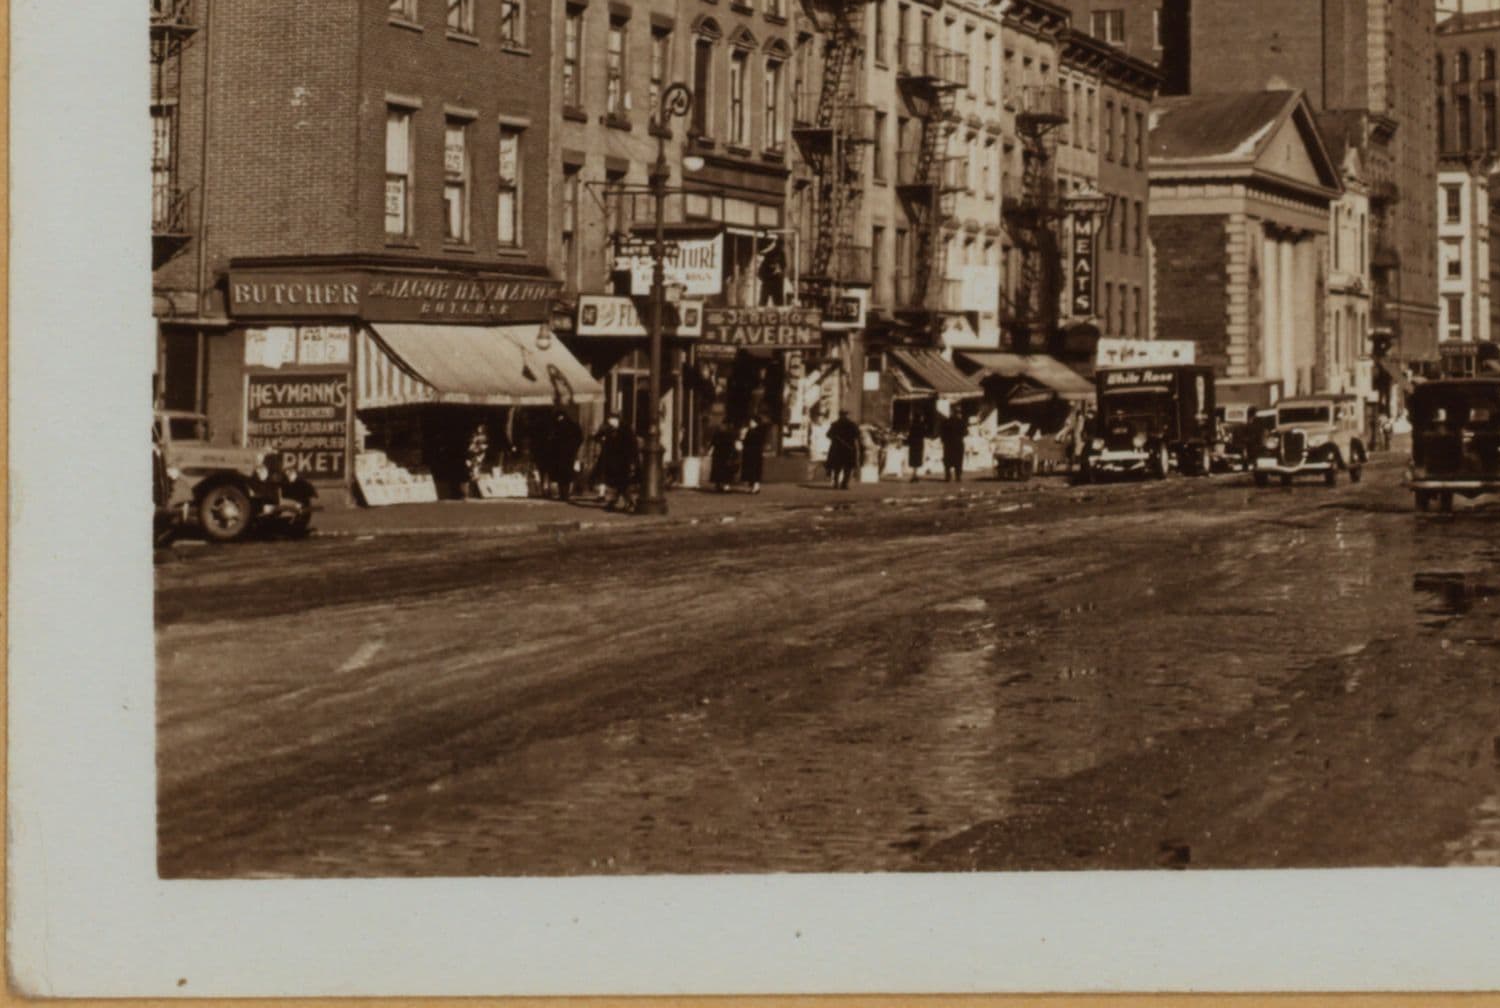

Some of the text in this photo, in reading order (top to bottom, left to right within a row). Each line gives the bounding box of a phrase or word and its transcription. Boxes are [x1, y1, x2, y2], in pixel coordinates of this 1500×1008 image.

[1074, 220, 1092, 309] MEATS
[234, 281, 359, 304] BUTCHER
[455, 281, 547, 302] HEYMANN
[719, 326, 811, 345] TAVERN
[249, 380, 348, 411] HEYMANN'S
[281, 452, 342, 472] RKET
